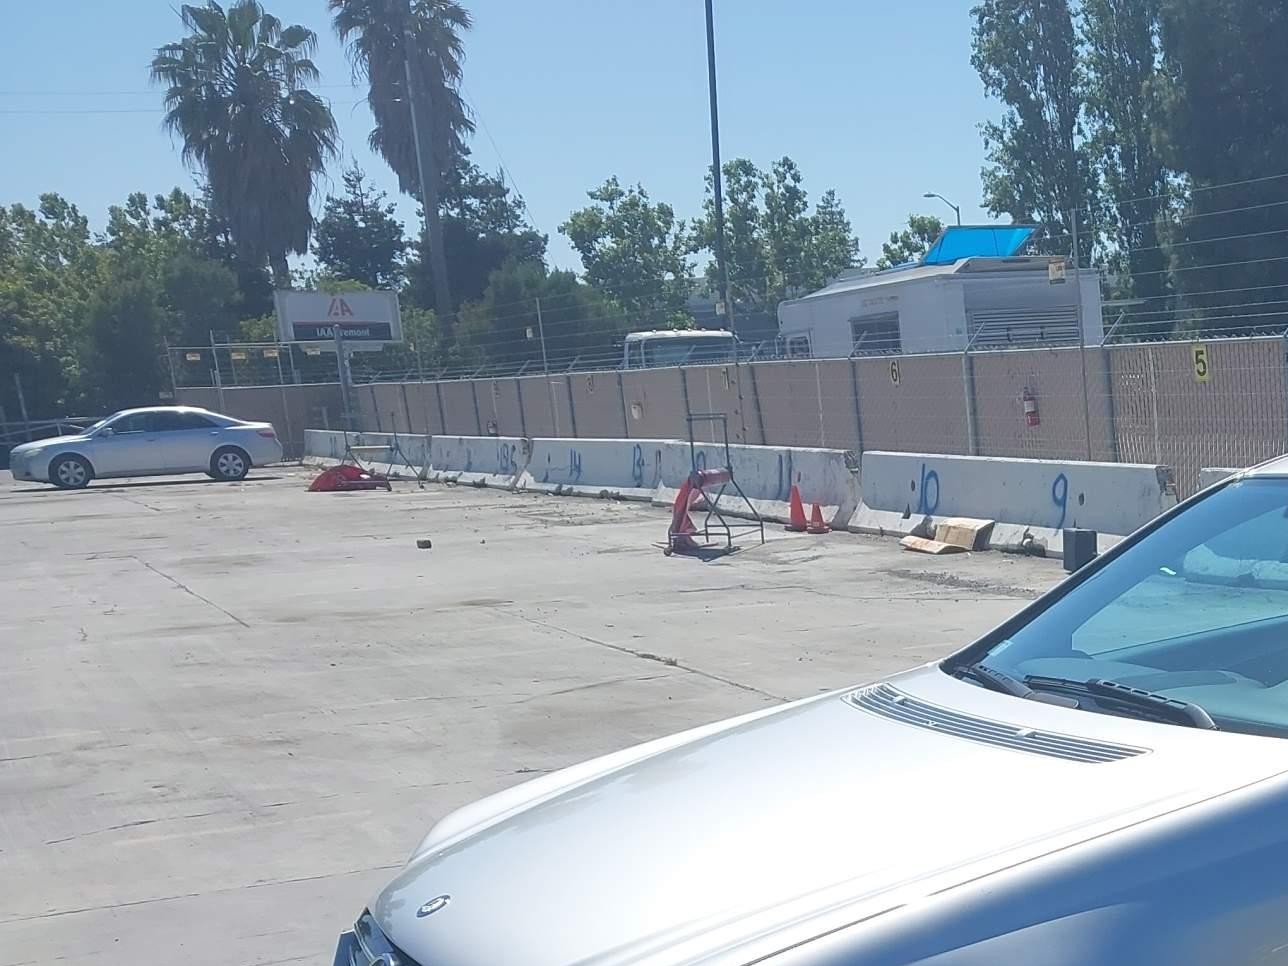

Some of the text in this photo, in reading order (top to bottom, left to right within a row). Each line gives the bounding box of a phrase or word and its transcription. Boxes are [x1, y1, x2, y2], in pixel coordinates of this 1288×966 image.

[316, 327, 370, 337] IAA remont
[890, 361, 898, 382] 6
[1195, 350, 1207, 377] 5
[917, 463, 940, 516] 10
[1052, 473, 1068, 536] 9
